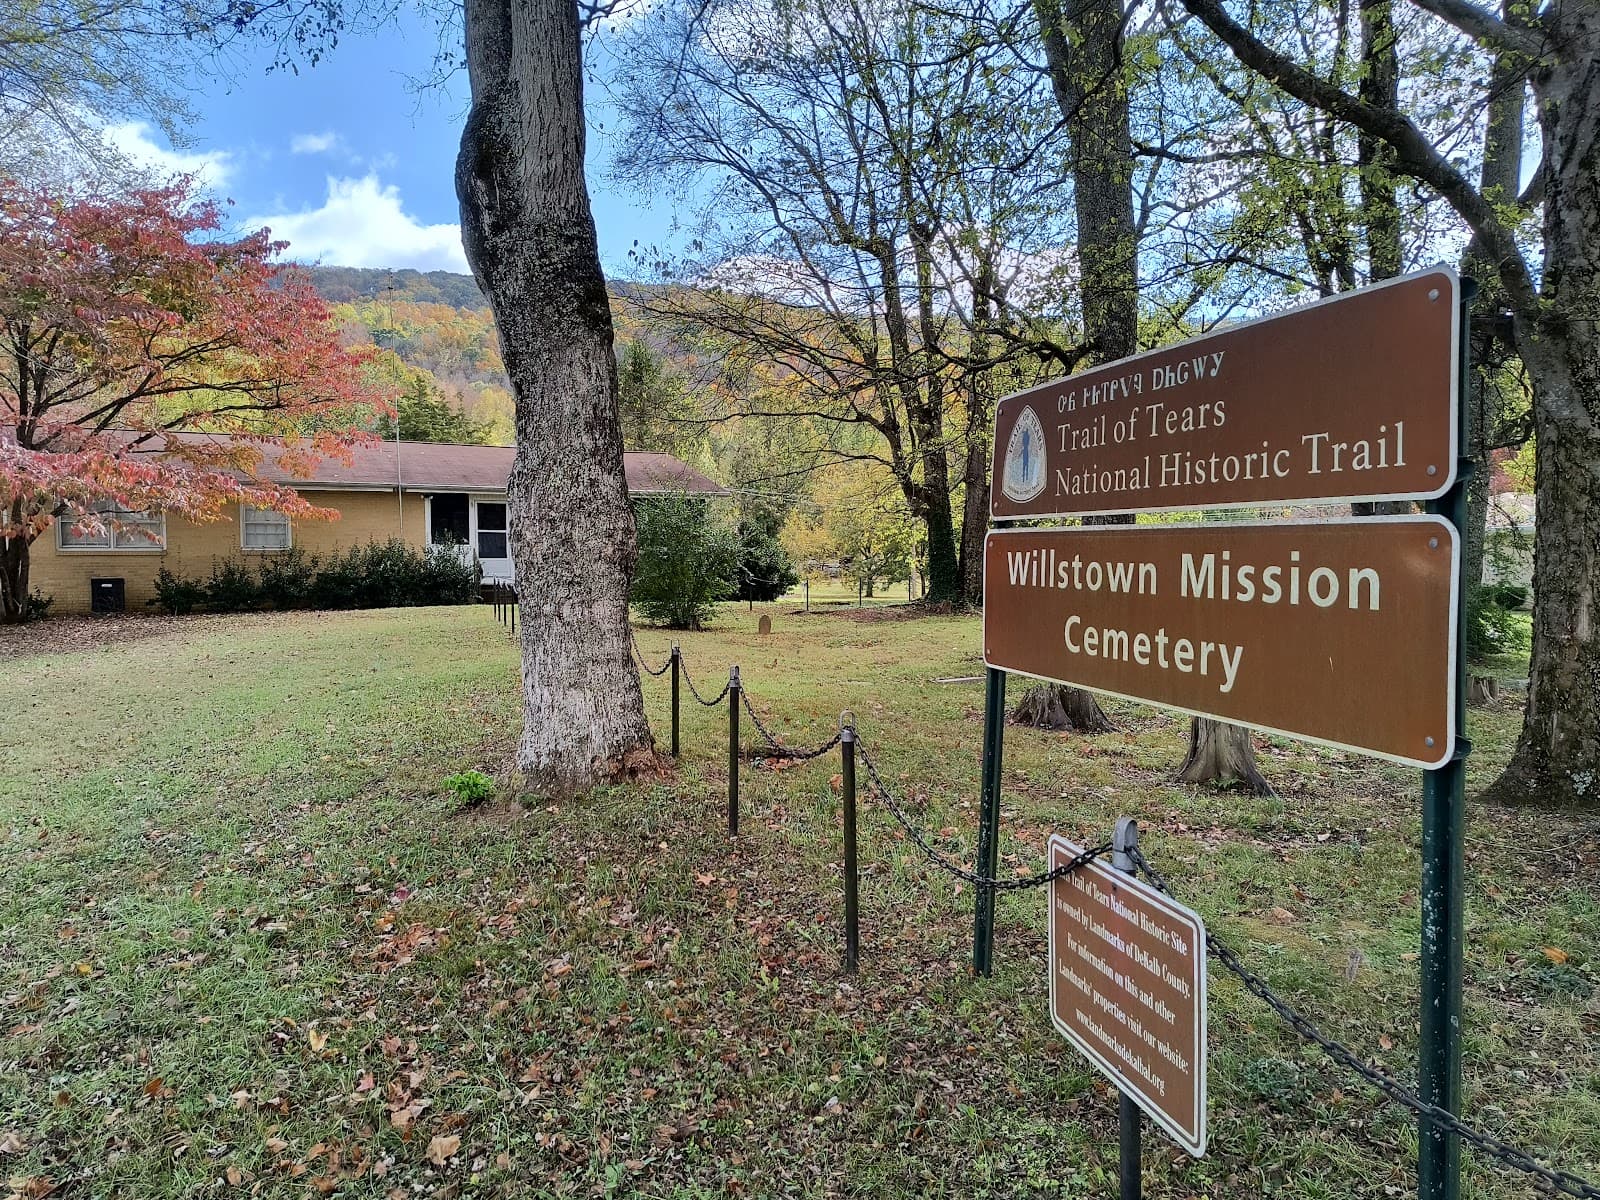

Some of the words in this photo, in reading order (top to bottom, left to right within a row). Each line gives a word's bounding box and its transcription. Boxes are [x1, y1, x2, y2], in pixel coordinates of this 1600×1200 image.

[1055, 456, 1150, 496] National
[1159, 441, 1290, 488] Historic
[1302, 421, 1406, 475] Trail
[1058, 415, 1105, 452] Trail
[1113, 407, 1139, 443] of
[1146, 400, 1226, 437] Tears
[1007, 549, 1158, 595] Willstown
[1181, 551, 1381, 611] Mission
[1065, 615, 1244, 693] Cemetery
[1057, 893, 1062, 909] is
[1063, 901, 1081, 922] owned
[1081, 909, 1089, 930] by
[1089, 914, 1125, 951] Landmarks
[1126, 942, 1134, 958] of
[1134, 947, 1161, 977] DeKalb
[1162, 963, 1191, 999] County.
[1071, 870, 1085, 892] Trail
[1086, 881, 1092, 896] of
[1092, 883, 1110, 907] Tears
[1111, 894, 1139, 925] National
[1140, 911, 1170, 945] Historic
[1171, 930, 1188, 956] Site
[1067, 932, 1077, 952] For
[1078, 940, 1114, 980] information
[1114, 972, 1124, 988] on
[1124, 975, 1139, 998] this
[1139, 988, 1153, 1010] and
[1154, 1000, 1176, 1025] other
[1075, 1008, 1165, 1097] www.landmarksdekalbal.org
[1093, 989, 1126, 1025] properties
[1127, 1014, 1143, 1038] visit
[1143, 1029, 1157, 1049] our
[1157, 1040, 1189, 1075] website:
